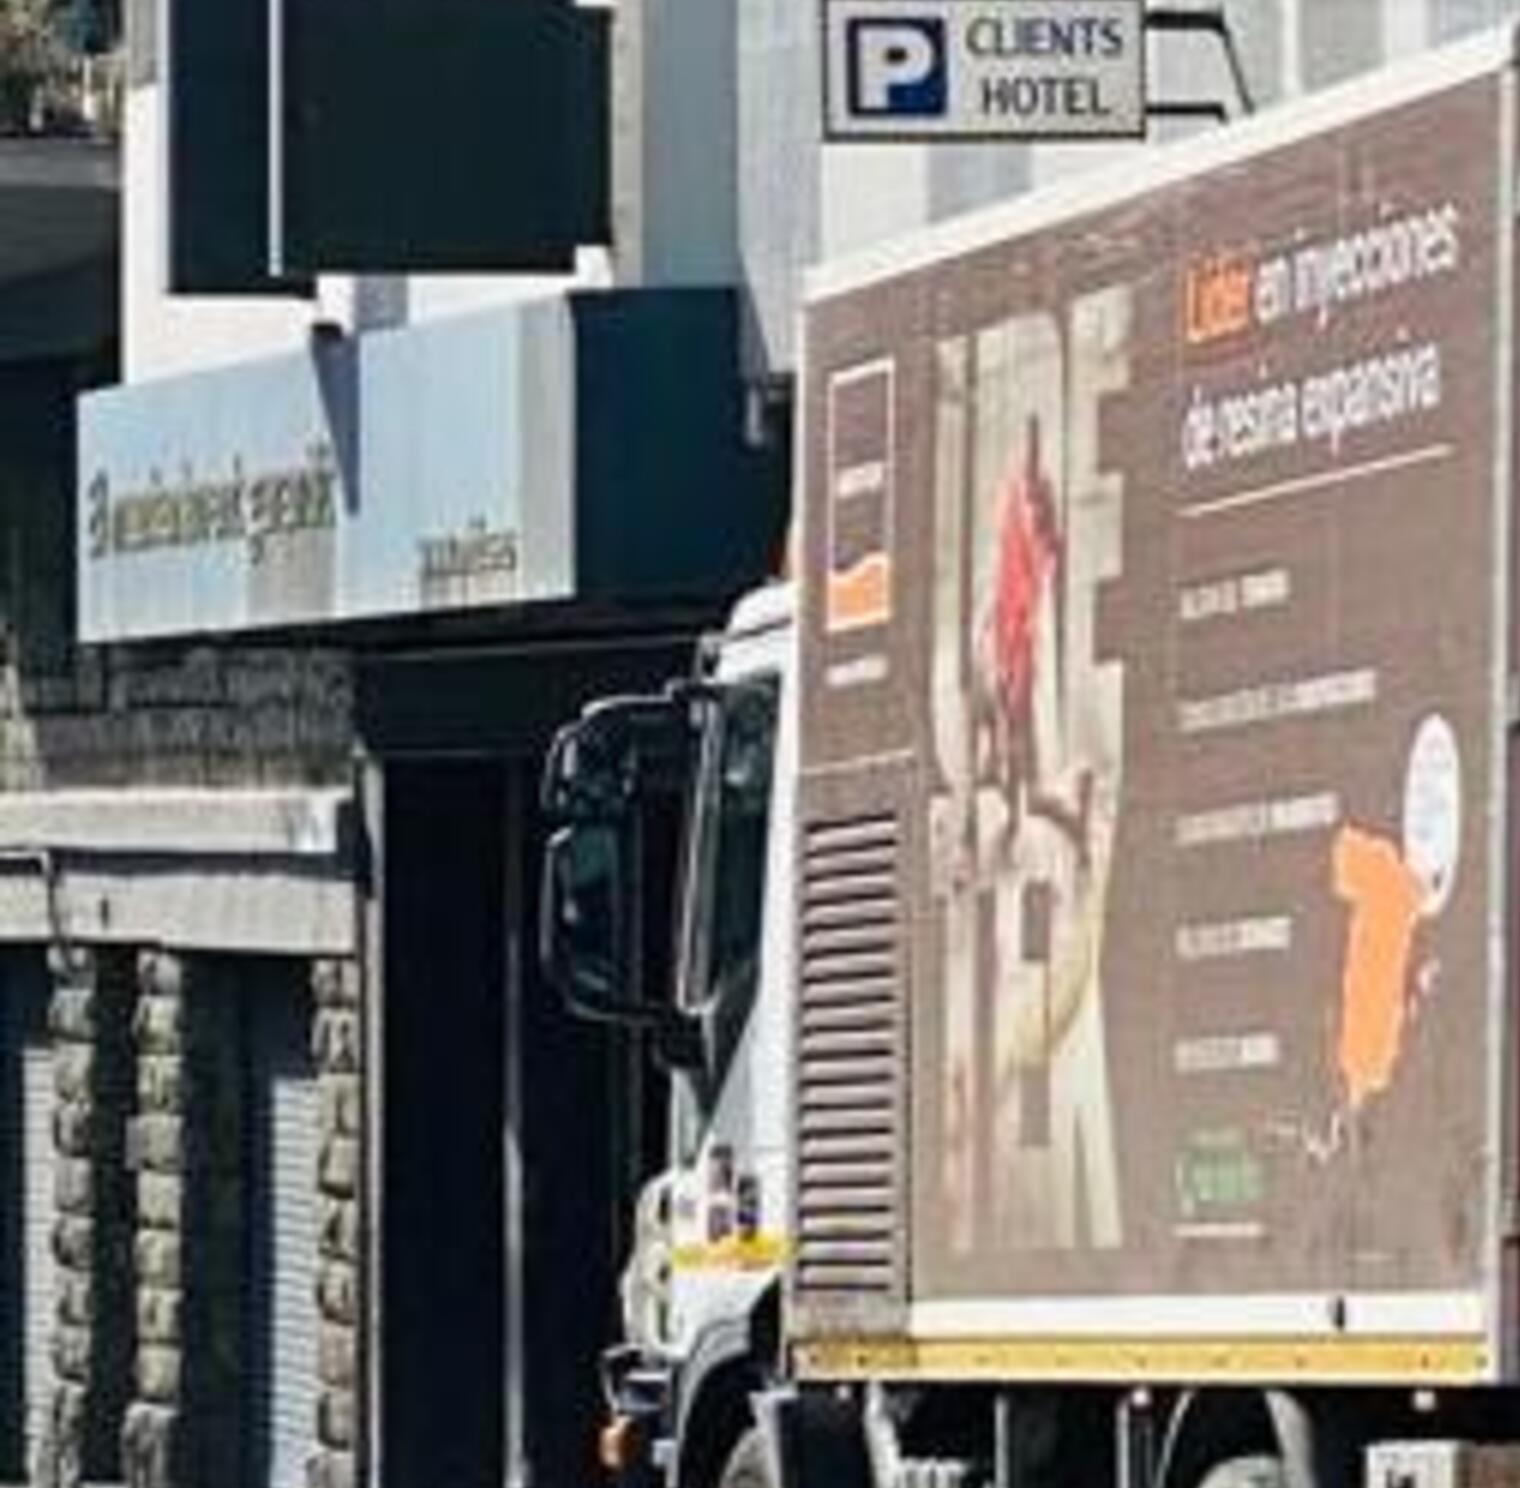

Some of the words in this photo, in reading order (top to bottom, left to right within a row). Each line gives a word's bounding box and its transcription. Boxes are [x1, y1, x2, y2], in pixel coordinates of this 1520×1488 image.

[965, 16, 1124, 57] CLIENTS
[859, 27, 935, 111] P
[979, 74, 1112, 115] HOTEL
